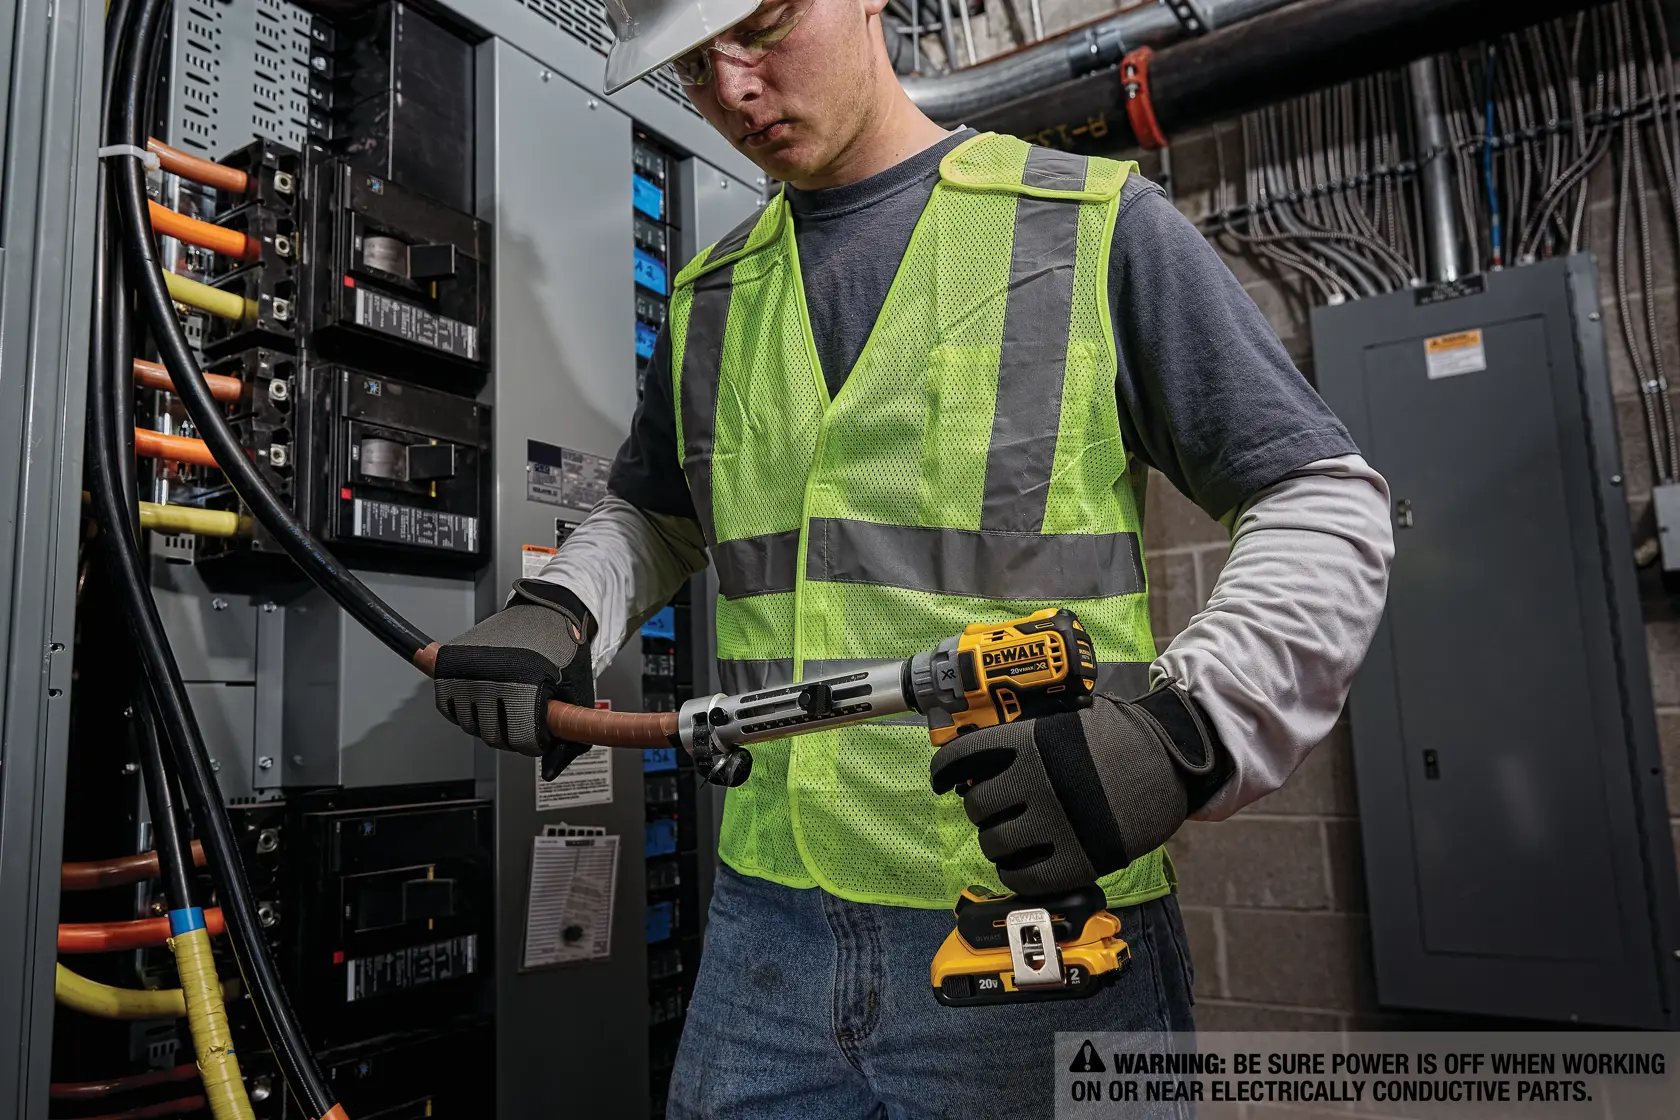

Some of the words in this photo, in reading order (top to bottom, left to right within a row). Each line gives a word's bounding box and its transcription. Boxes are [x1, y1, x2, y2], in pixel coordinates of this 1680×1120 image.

[982, 642, 1045, 666] DEWALT
[1036, 662, 1047, 670] XR
[941, 668, 956, 681] XR
[1070, 968, 1080, 980] 2
[979, 978, 998, 989] 20V
